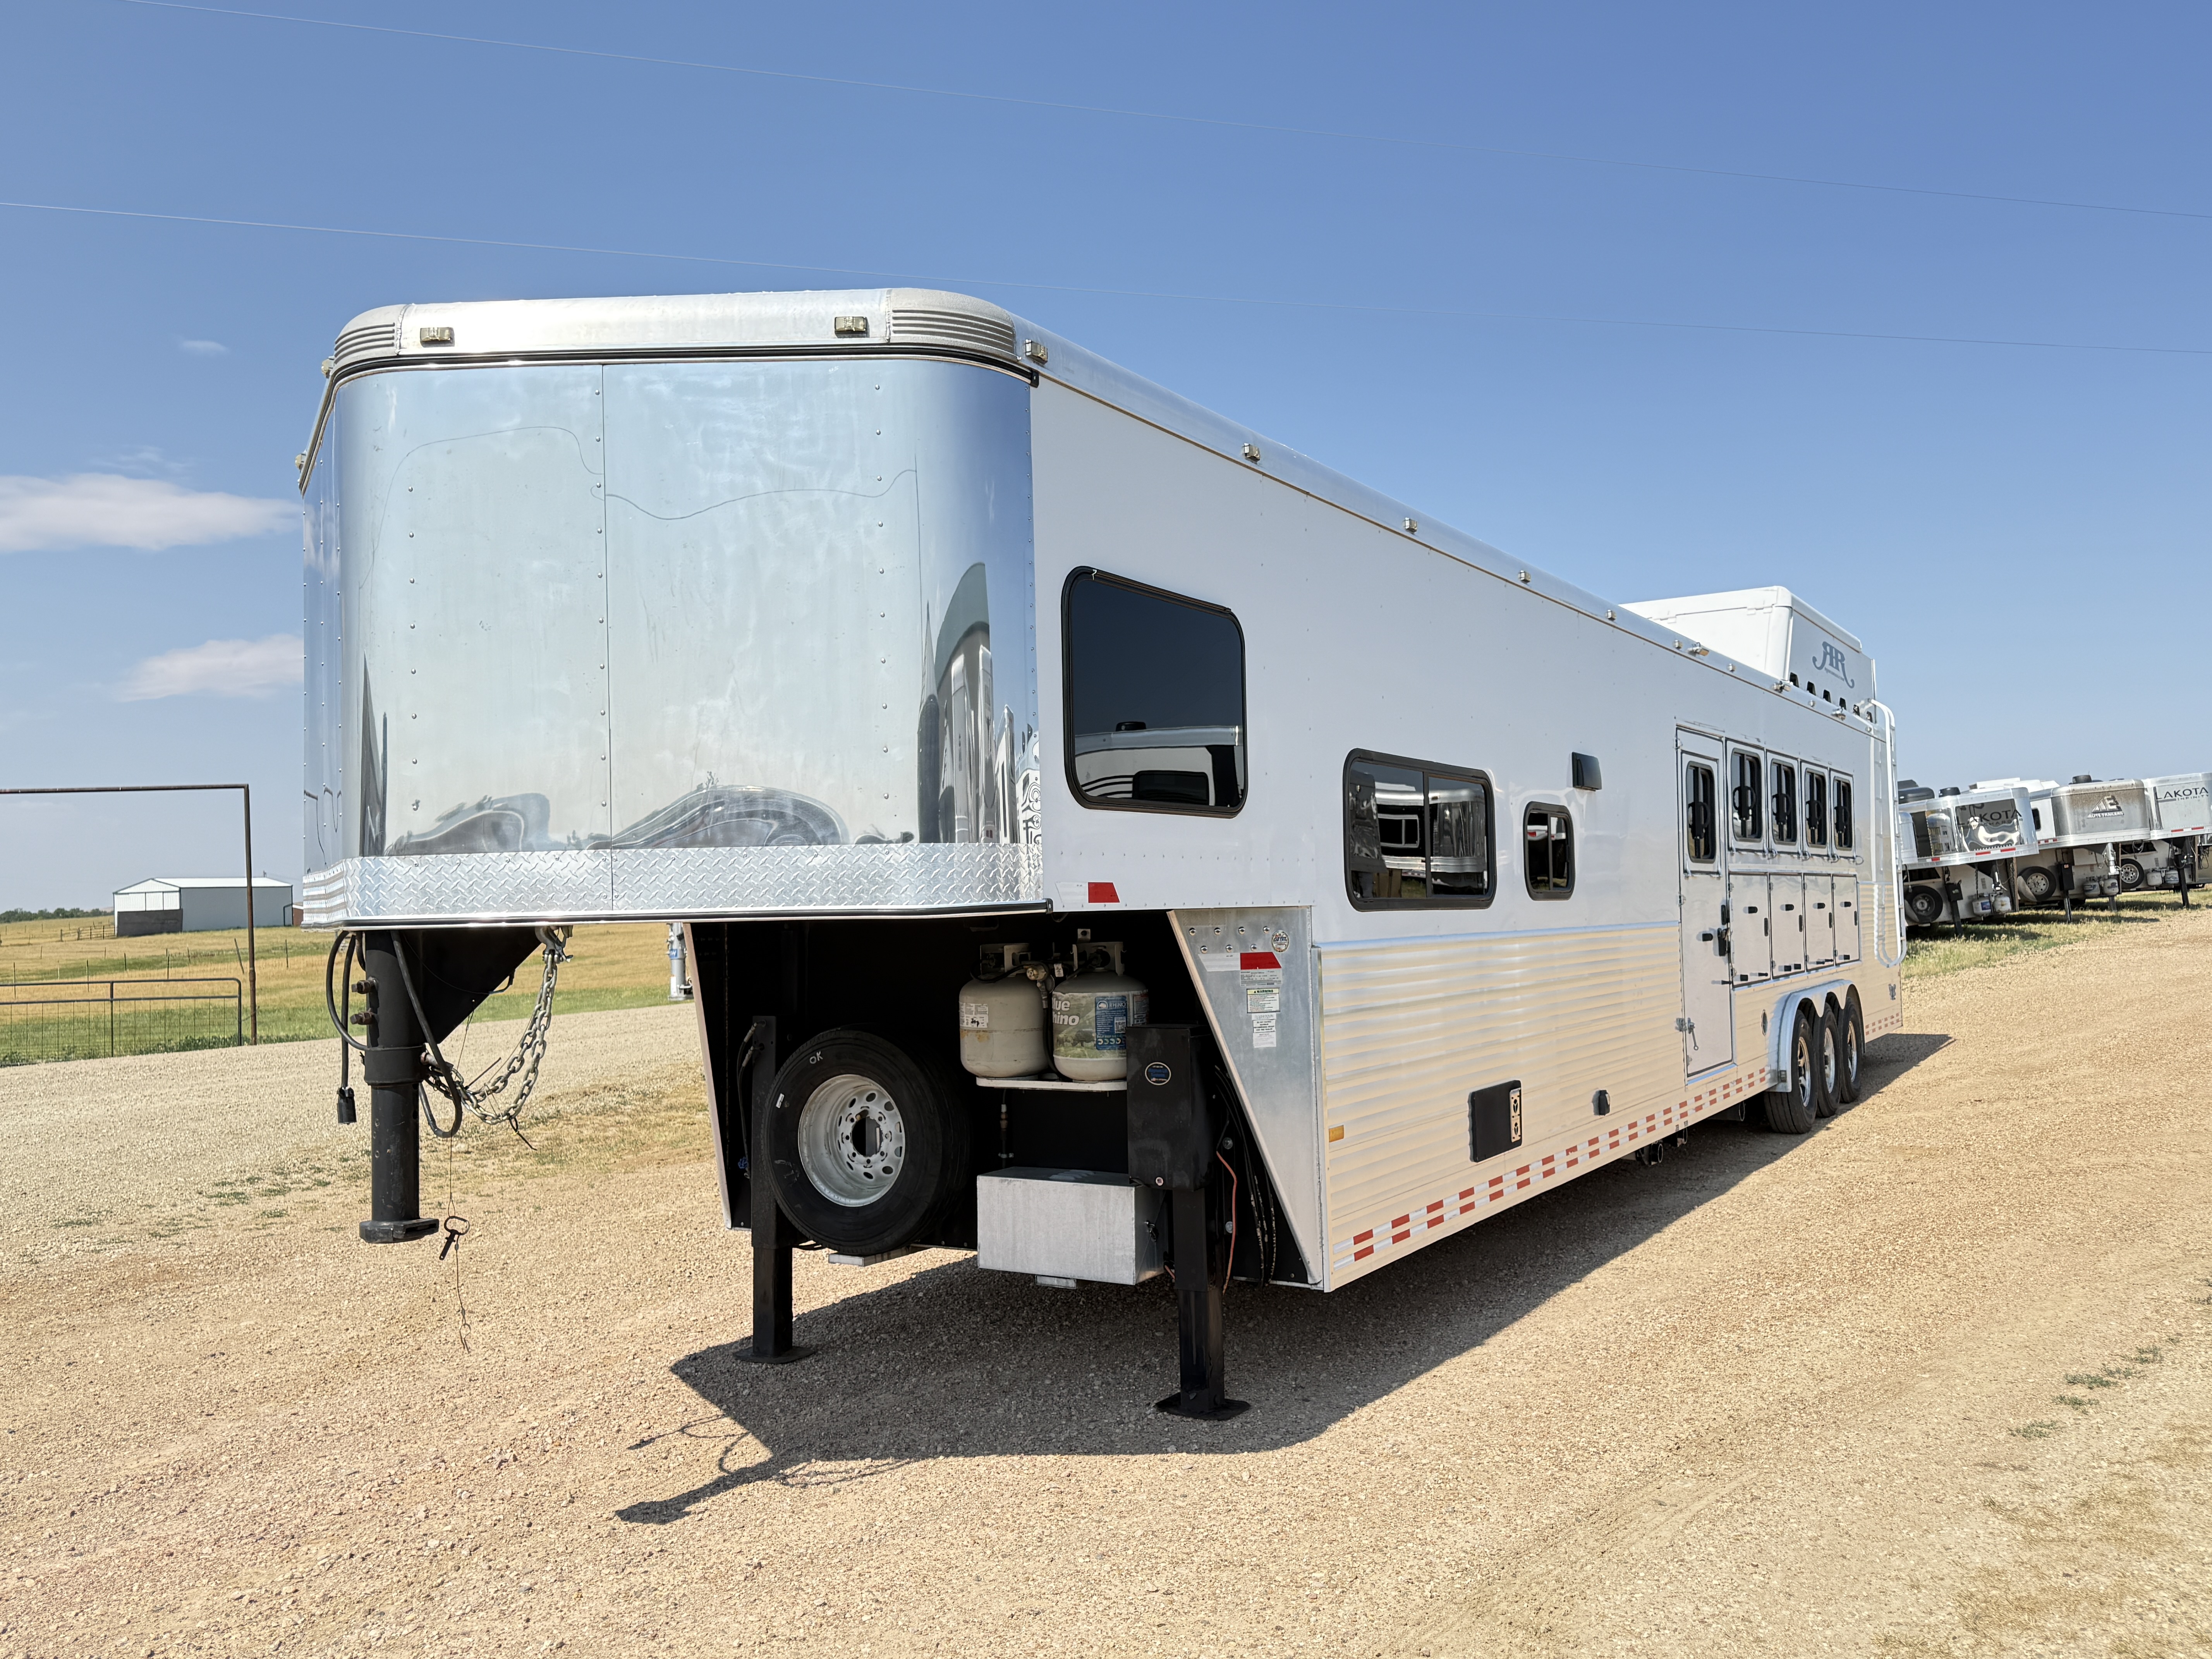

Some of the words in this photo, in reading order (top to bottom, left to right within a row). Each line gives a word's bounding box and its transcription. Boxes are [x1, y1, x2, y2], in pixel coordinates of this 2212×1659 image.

[2155, 787, 2209, 800] LAKOTA
[1052, 998, 1070, 1011] lue
[1053, 1011, 1079, 1026] hino
[809, 1051, 823, 1064] OK
